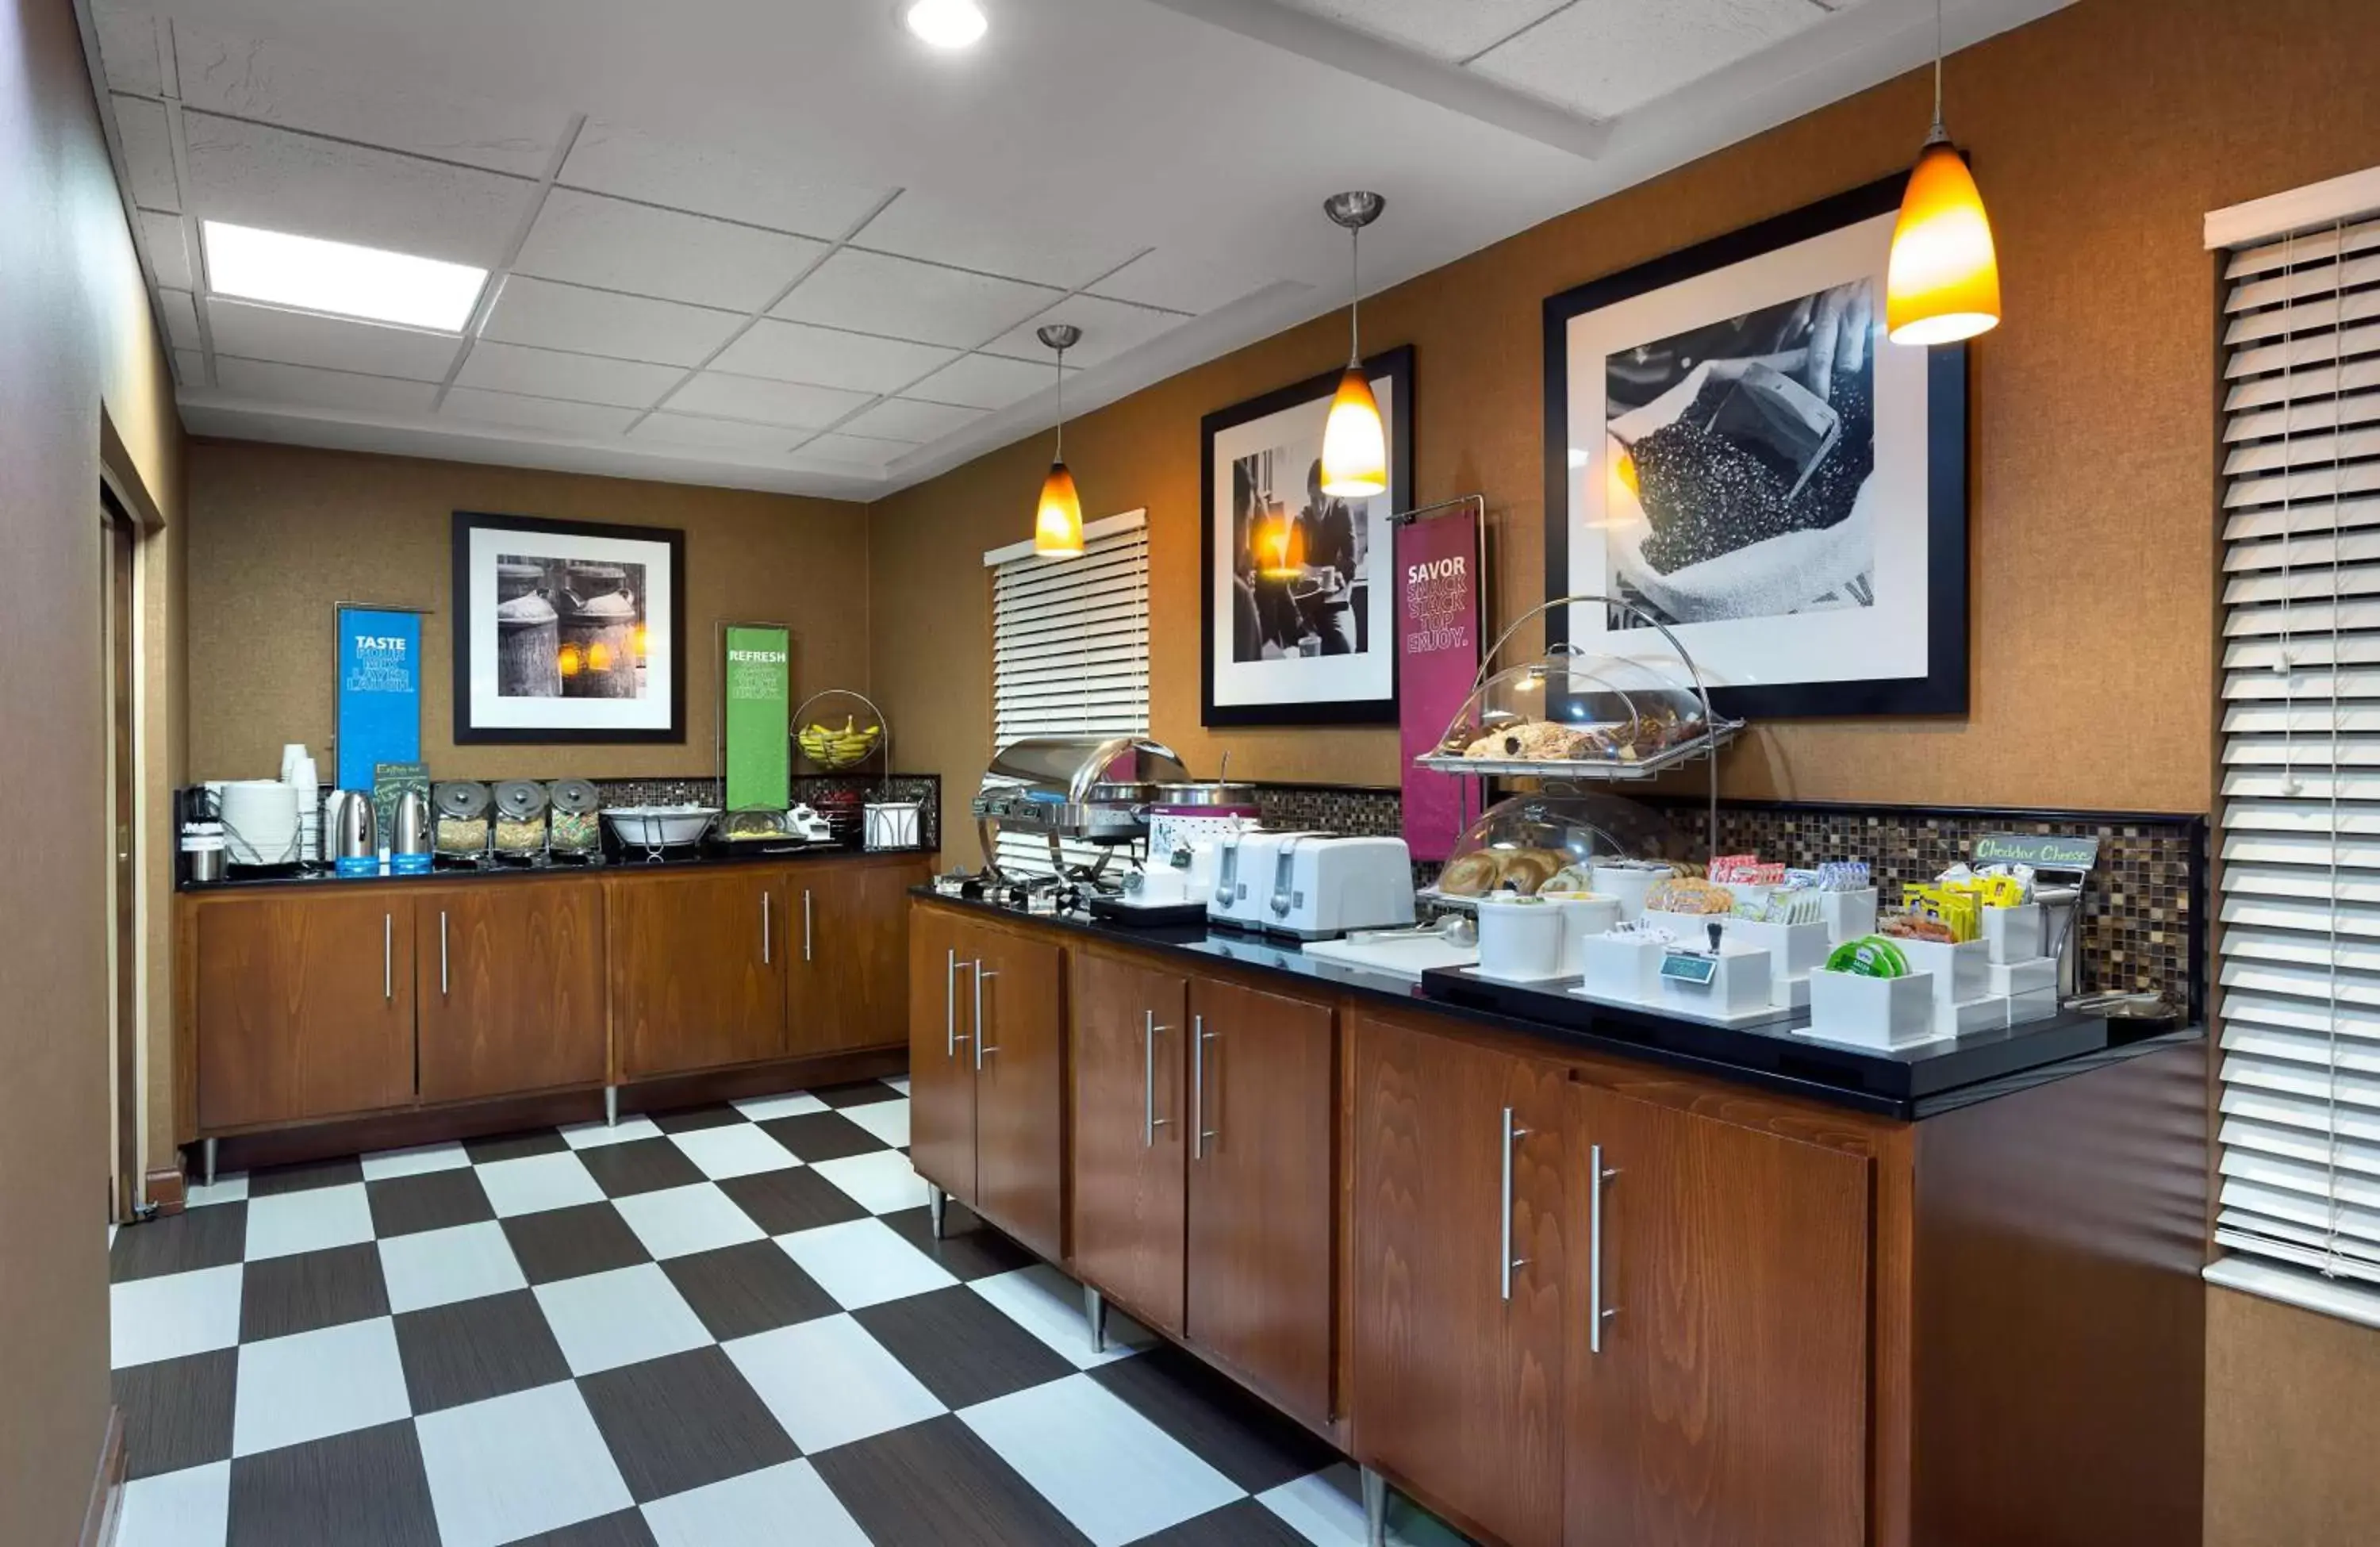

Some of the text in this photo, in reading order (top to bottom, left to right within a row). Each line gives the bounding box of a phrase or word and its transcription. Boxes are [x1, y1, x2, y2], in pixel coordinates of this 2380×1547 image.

[1408, 556, 1465, 583] SAVOR
[1419, 611, 1454, 631] TOP
[355, 635, 406, 650] TASTE
[728, 650, 786, 662] REFRESH
[1976, 839, 2092, 862] Cheddar Cheese
